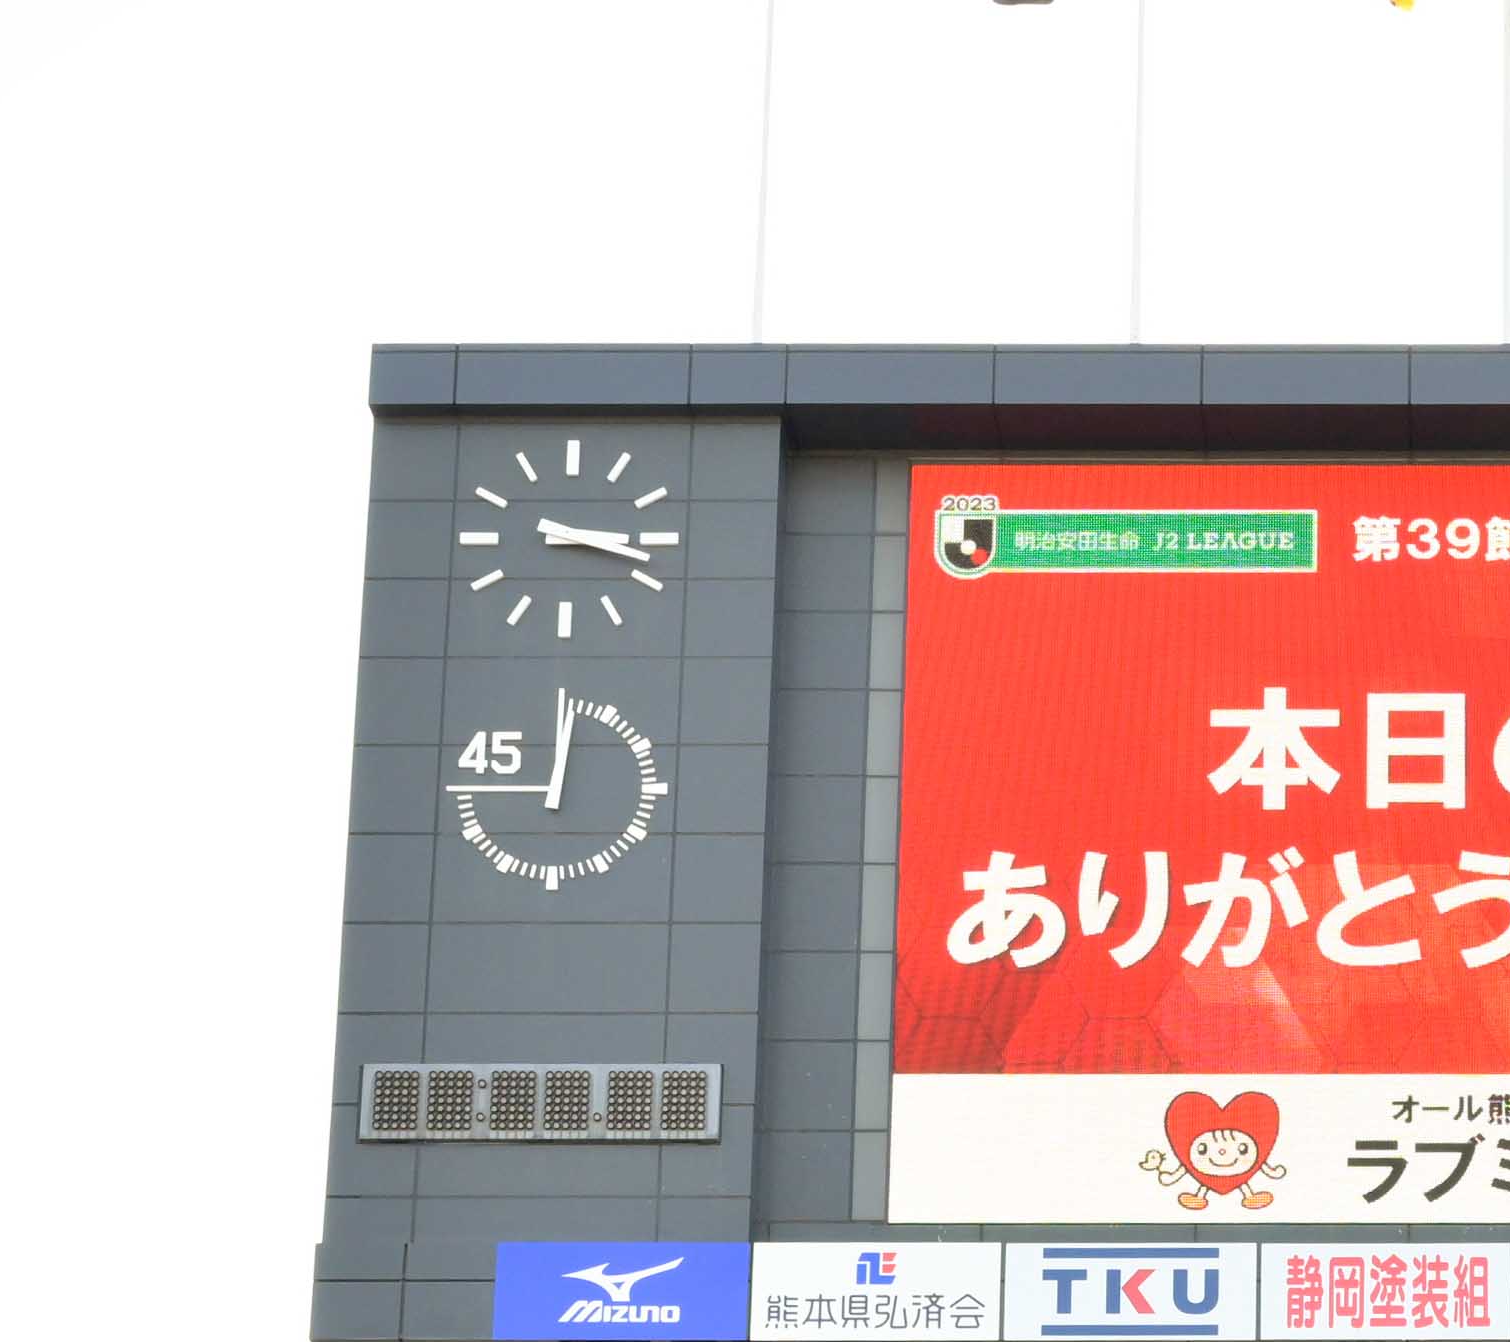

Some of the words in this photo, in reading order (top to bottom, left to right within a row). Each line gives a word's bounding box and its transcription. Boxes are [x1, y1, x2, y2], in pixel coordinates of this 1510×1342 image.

[1013, 529, 1140, 552] 明治安田生命
[1151, 529, 1180, 551] J2
[1185, 529, 1296, 551] LEAGUE
[457, 730, 523, 774] 45
[1042, 1266, 1221, 1315] TKU
[1284, 1254, 1491, 1331] 静岡塗装組
[765, 1294, 987, 1332] 熊本県弘済会
